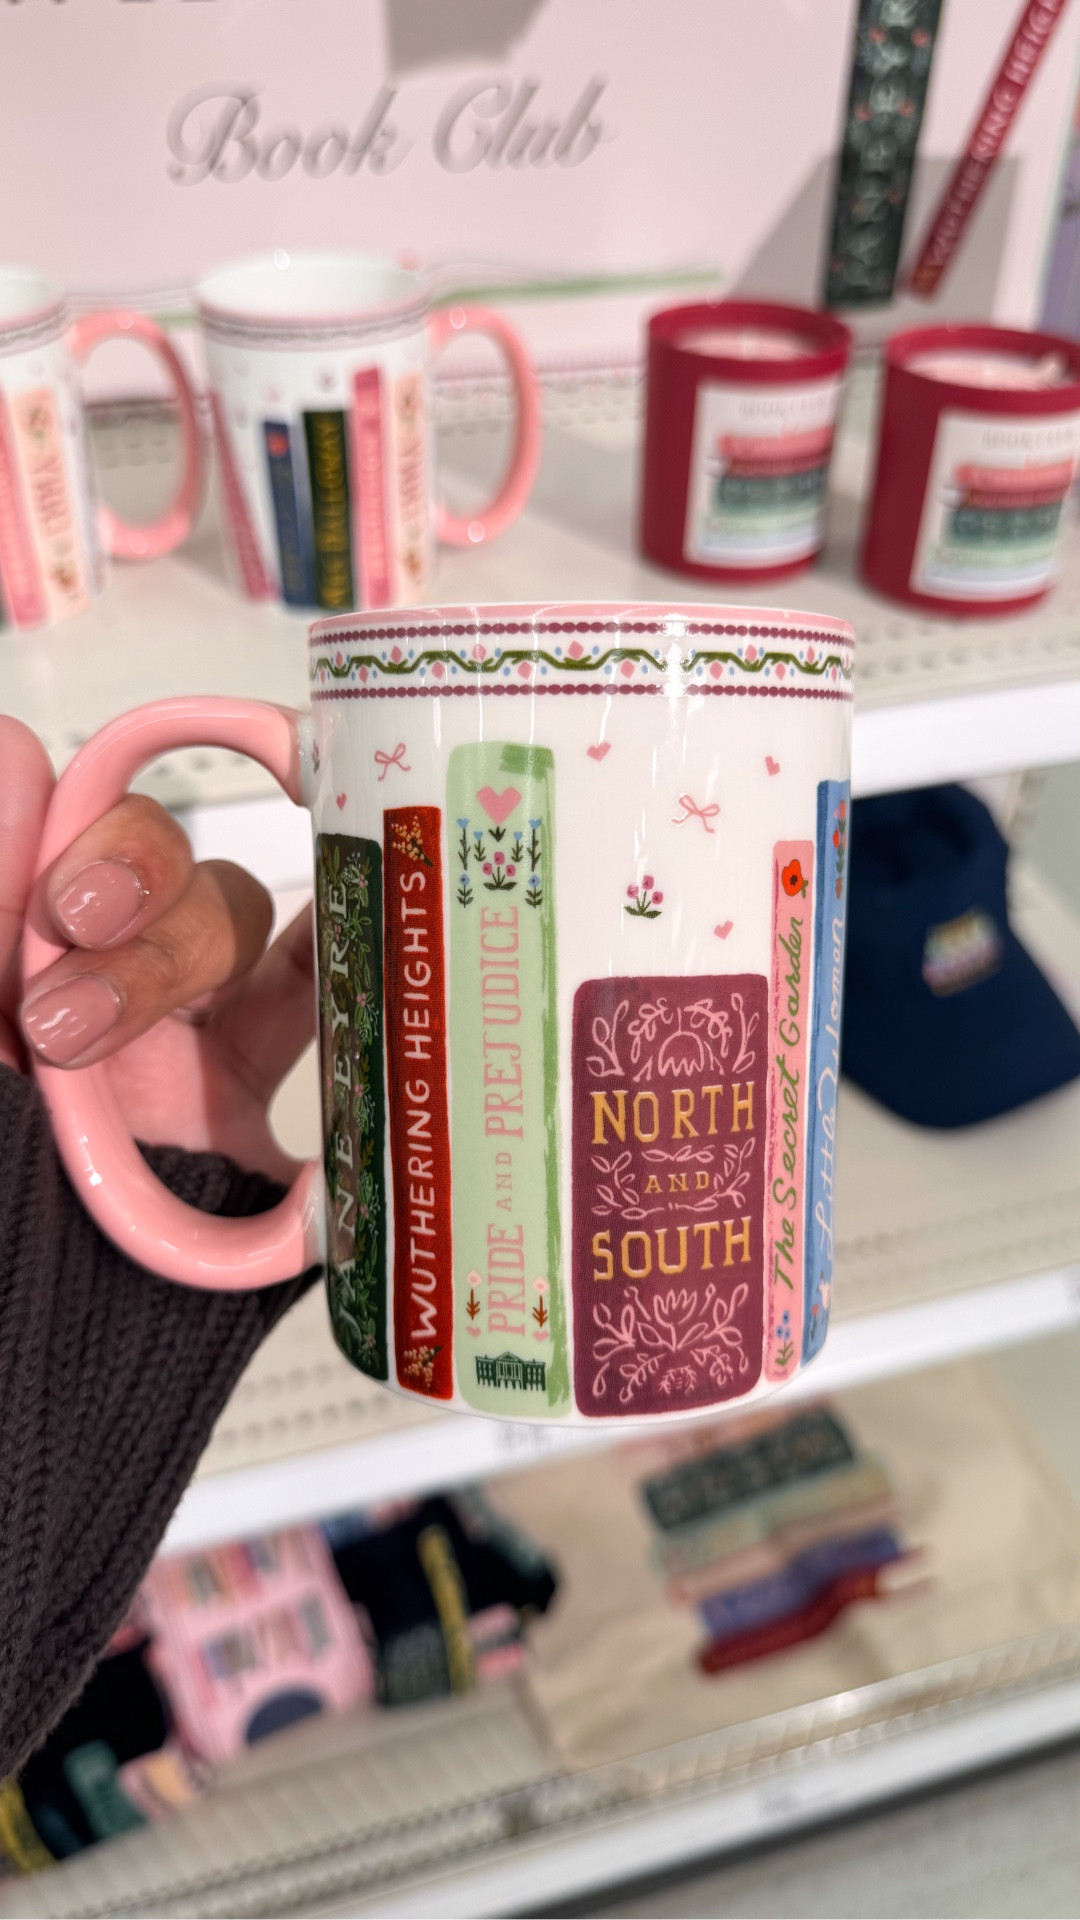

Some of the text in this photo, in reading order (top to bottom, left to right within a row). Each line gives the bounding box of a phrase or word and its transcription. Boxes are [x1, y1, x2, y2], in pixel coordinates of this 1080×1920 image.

[165, 72, 616, 187] Book Club
[329, 883, 361, 1347] JANE EYRE
[400, 871, 437, 1340] WUTHERING HEIGHTS
[480, 906, 526, 1337] PRIDE AND PREJUDICE
[590, 1081, 755, 1144] NORTH
[643, 1171, 710, 1194] AND
[773, 916, 804, 1291] The Secret Garden
[592, 1216, 752, 1281] SOUTH
